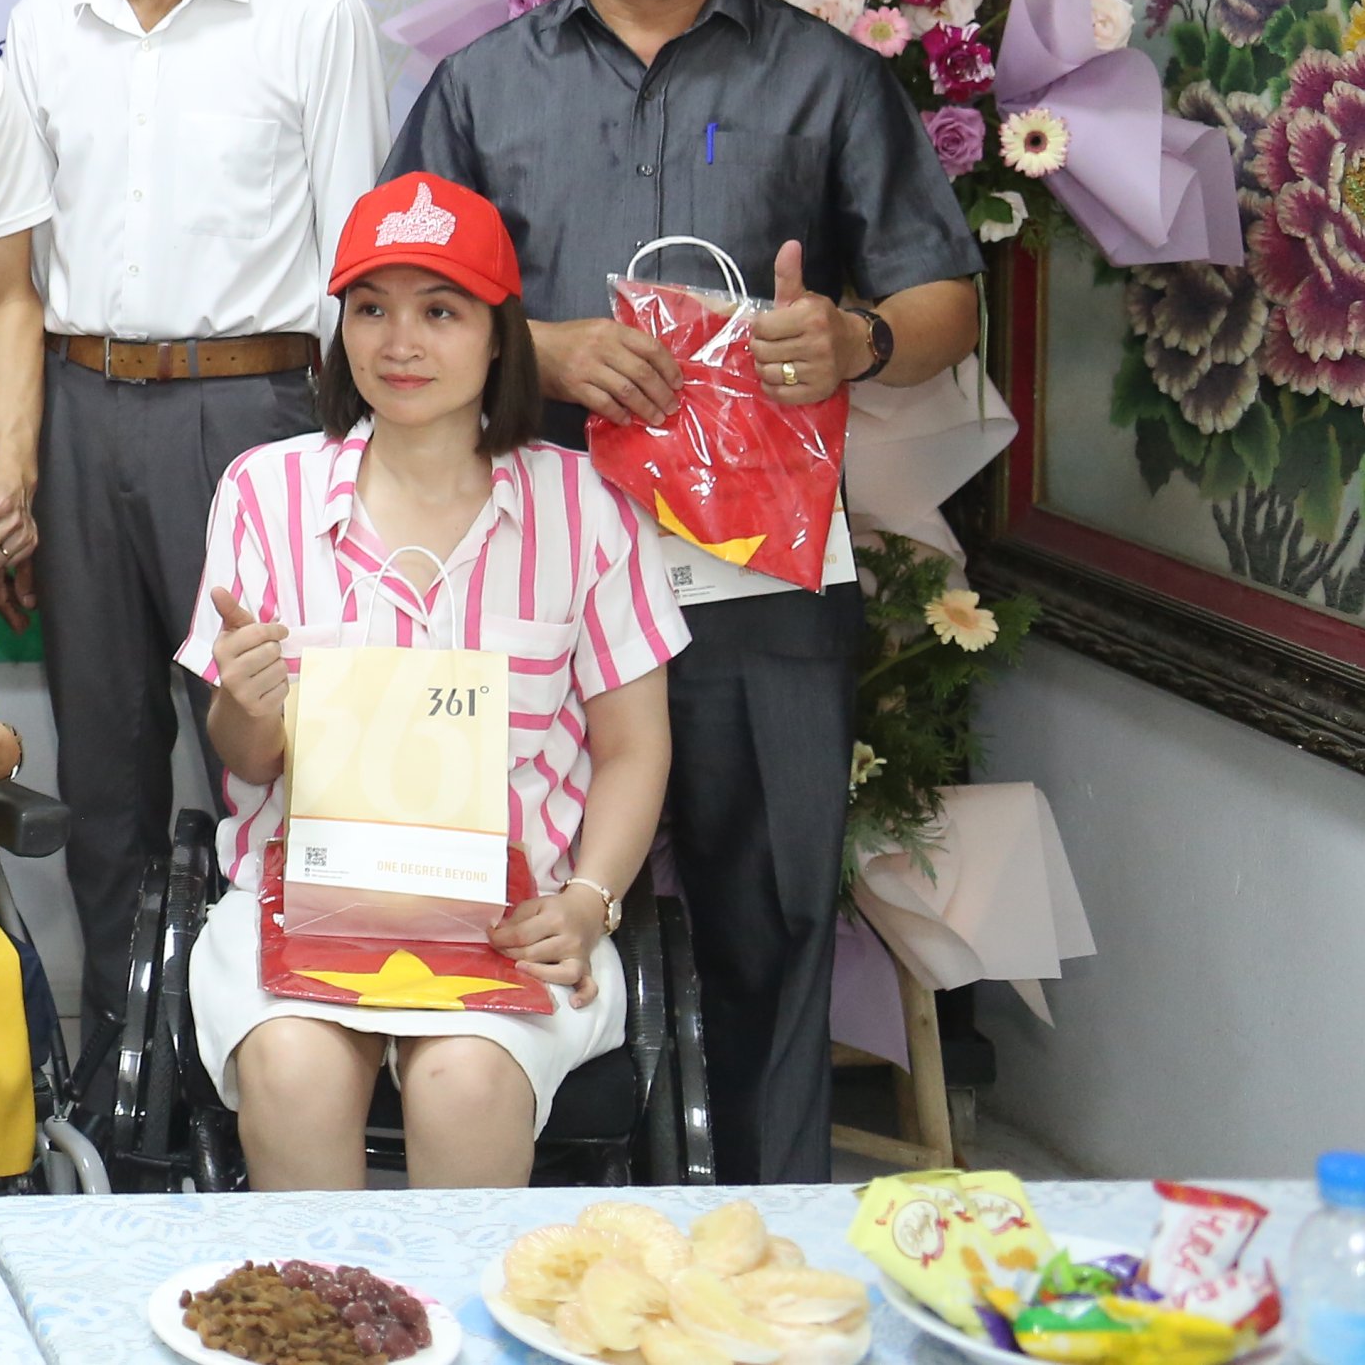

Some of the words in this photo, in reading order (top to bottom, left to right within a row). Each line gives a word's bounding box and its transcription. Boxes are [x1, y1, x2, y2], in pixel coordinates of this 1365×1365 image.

[427, 685, 490, 718] 361°
[377, 861, 398, 874] ONE
[400, 862, 443, 878] DEGREE
[445, 865, 488, 883] BEYOND
